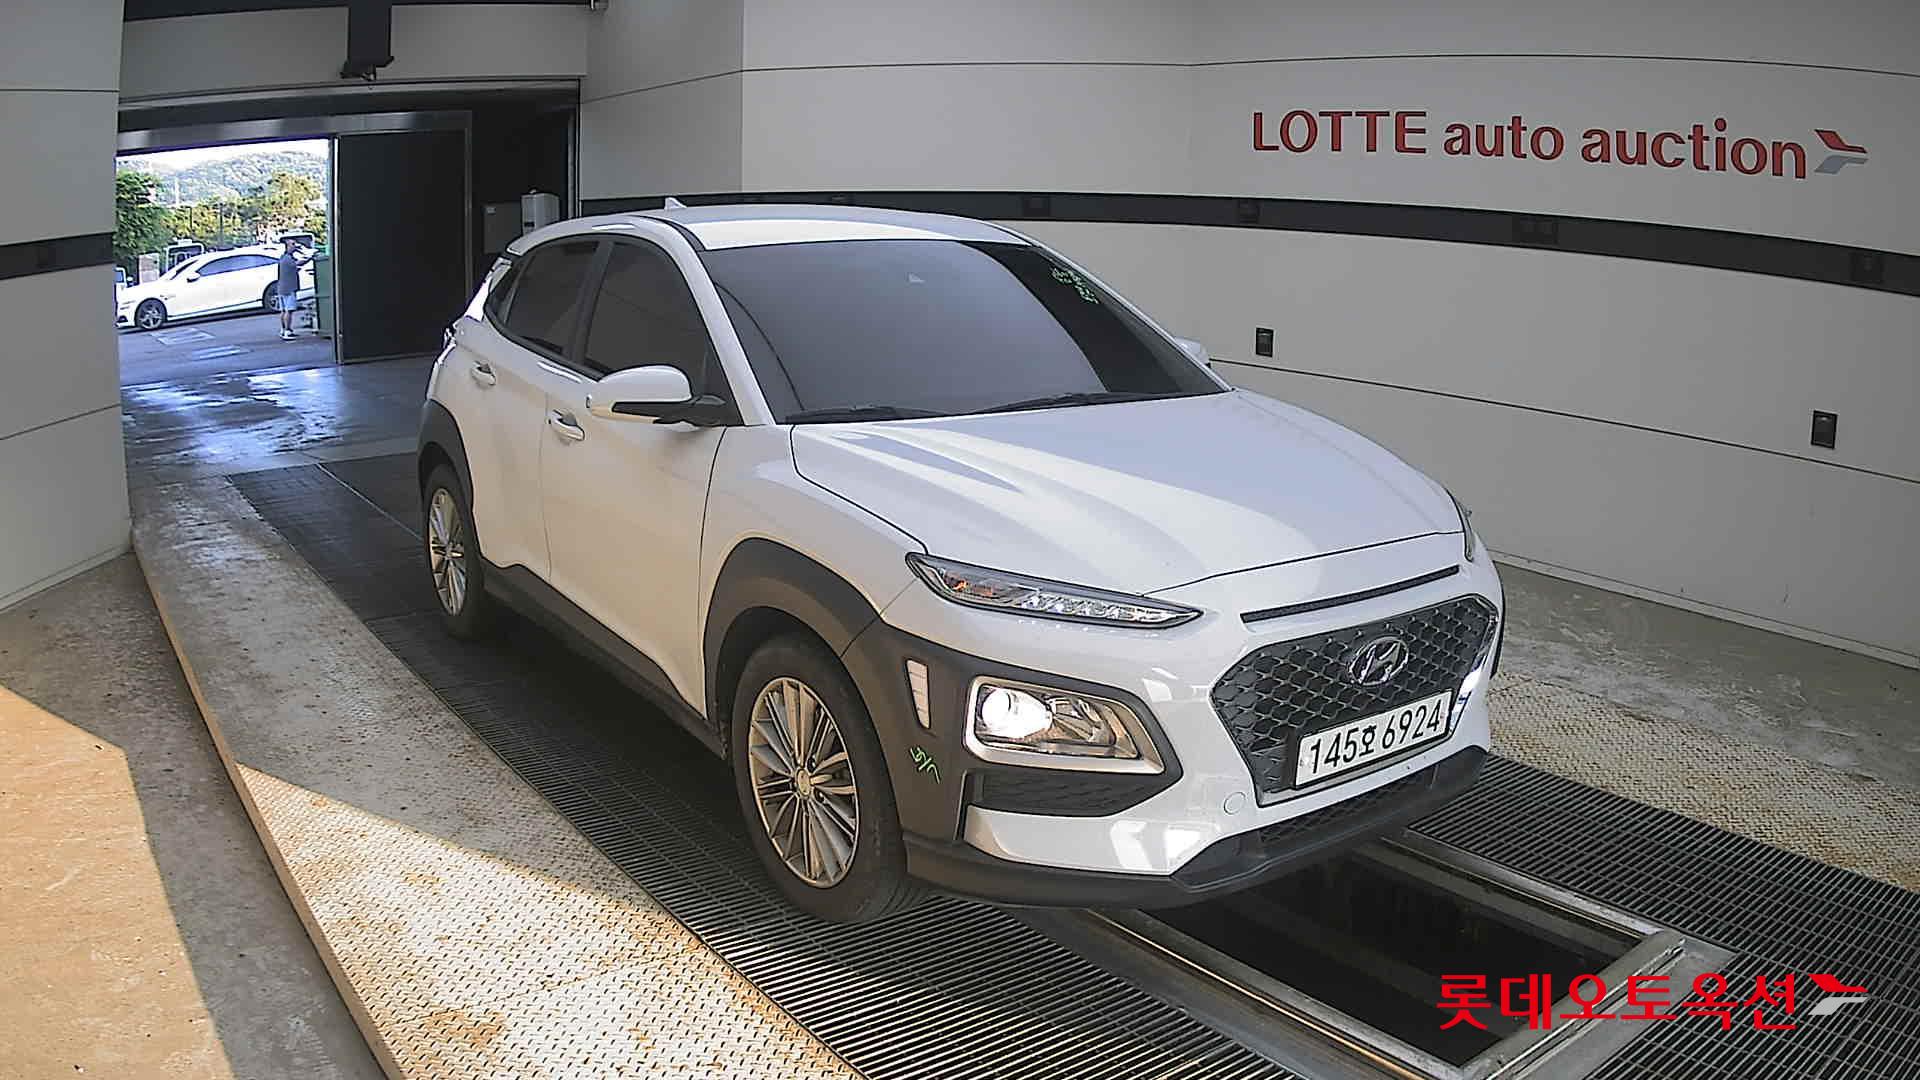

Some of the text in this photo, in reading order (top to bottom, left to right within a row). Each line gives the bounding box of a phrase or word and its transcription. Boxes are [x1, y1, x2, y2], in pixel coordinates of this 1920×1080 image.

[1253, 110, 1807, 179] LOTTE auto auction
[1310, 699, 1442, 774] 145호 6924
